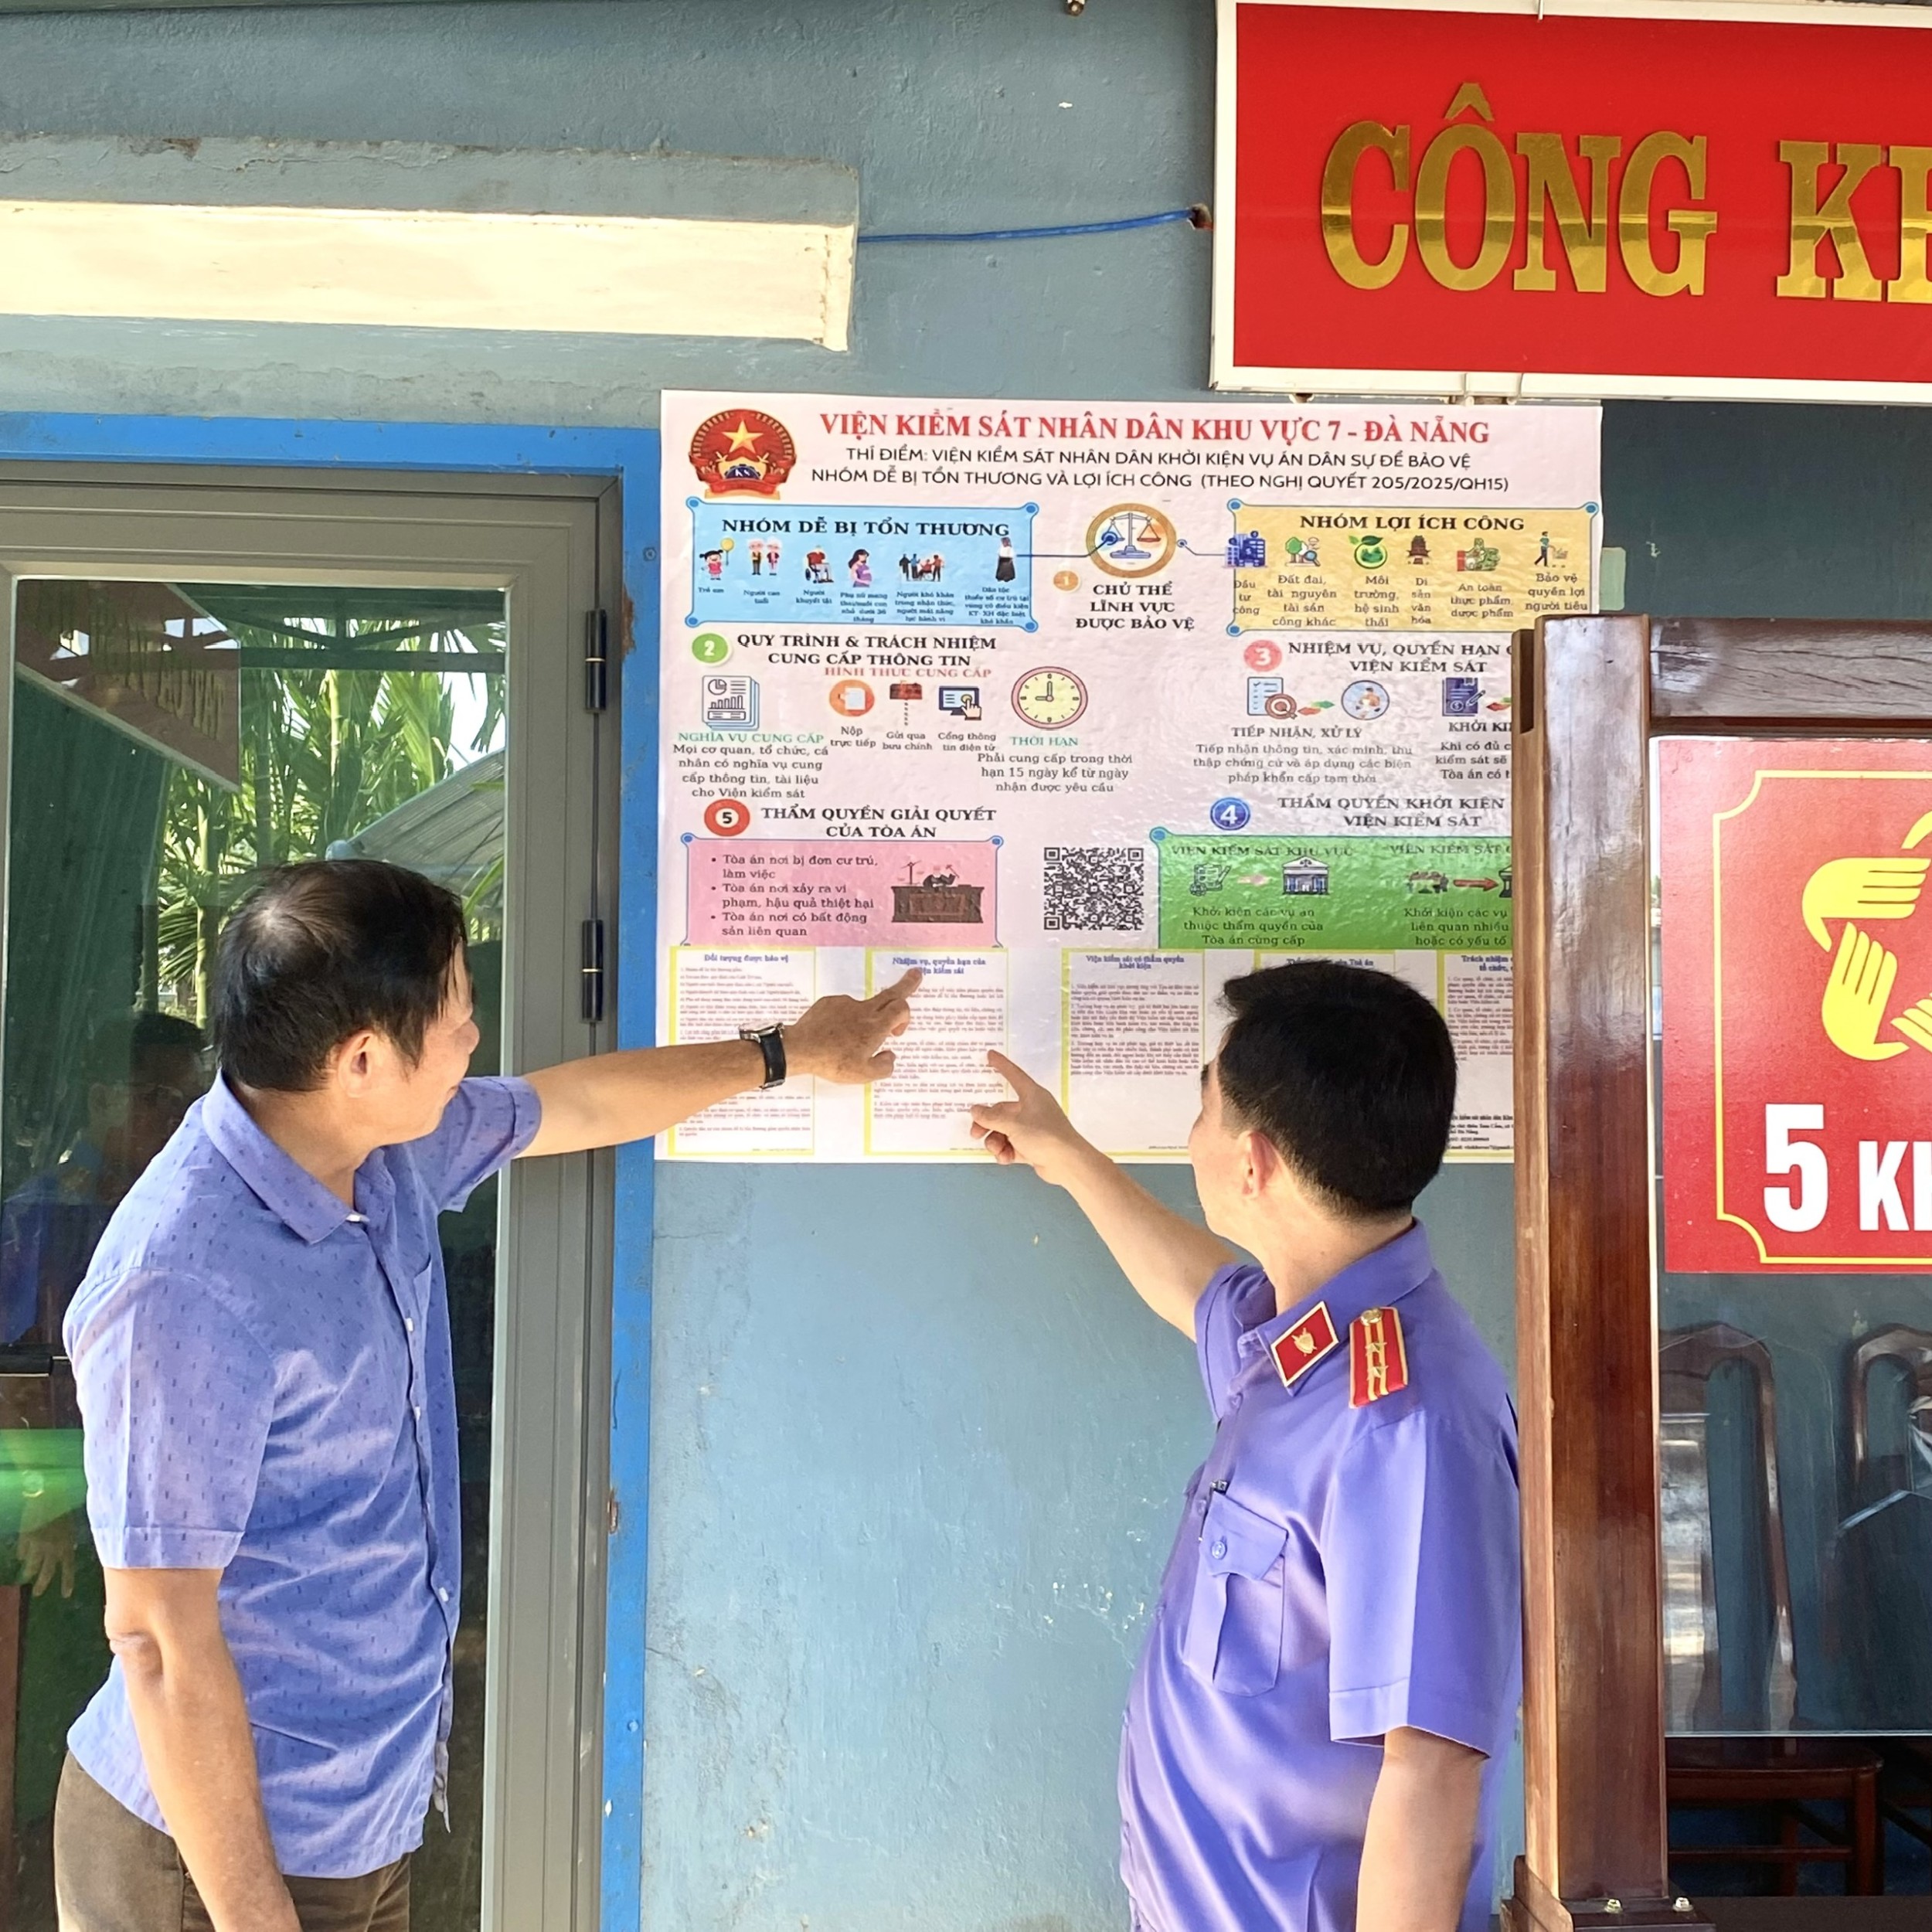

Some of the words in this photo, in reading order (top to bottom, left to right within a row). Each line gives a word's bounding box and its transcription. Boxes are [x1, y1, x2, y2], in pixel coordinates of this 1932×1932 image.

[1321, 82, 1718, 297] CÔNG
[820, 410, 887, 440] VIỆN
[896, 409, 970, 437] KIỂM
[978, 410, 1031, 437] SÁT
[1039, 411, 1117, 439] NHÂN
[1126, 411, 1183, 440] DÂN
[1192, 419, 1252, 440] KHU
[1260, 417, 1320, 445] VỰC
[1328, 420, 1341, 441] 7
[1365, 414, 1402, 442] ĐÀ
[1410, 415, 1488, 443] NẴNG
[846, 445, 874, 461] THÍ
[879, 444, 927, 461] ĐIỂM:
[932, 447, 971, 464] VIỆN
[978, 445, 1018, 463] KIỂM
[1023, 447, 1054, 463] SÁT
[1060, 448, 1109, 464] NHÂN
[1116, 449, 1152, 464] DÂN
[1158, 449, 1200, 465] KHỞI
[1206, 450, 1243, 468] KIỆN
[1249, 453, 1274, 468] VỤ
[1278, 451, 1302, 466] ÁN
[1308, 451, 1345, 467] DÂN
[1351, 454, 1376, 469] SỰ
[1380, 450, 1403, 467] ĐỂ
[1409, 452, 1444, 468] BẢO
[1449, 452, 1470, 470] VỆ
[812, 467, 868, 482] NHÓM
[873, 465, 896, 483] DỄ
[903, 471, 917, 485] BỊ
[922, 465, 958, 484] TỔN
[964, 471, 1042, 485] THƯƠNG
[1046, 470, 1069, 485] VÀ
[1074, 473, 1100, 488] LỢI
[1107, 471, 1134, 486] ÍCH
[1140, 471, 1192, 487] CÔNG
[1202, 474, 1254, 489] (THEO
[1260, 474, 1302, 491] NGHỊ
[1308, 471, 1366, 488] QUYẾT
[1372, 477, 1509, 492] 205/2025/QH15)
[723, 517, 791, 532] NHÓM
[799, 517, 827, 533] DỄ
[835, 521, 856, 536] BỊ
[864, 518, 909, 535] TỔN
[916, 522, 1009, 536] THƯƠNG
[1301, 513, 1368, 529] NHÓM
[1376, 517, 1410, 532] LỢI
[1419, 514, 1456, 530] ÍCH
[1464, 515, 1524, 530] CÔNG
[1278, 574, 1300, 583] Đất
[1366, 576, 1389, 584] Môi
[1094, 582, 1131, 595] CHỦ
[1137, 581, 1172, 595] THỂ
[1267, 588, 1283, 597] tài
[1291, 589, 1336, 600] nguyên
[1090, 600, 1133, 612] LĨNH
[1140, 602, 1175, 616] VỰC
[1077, 618, 1124, 631] ĐƯỢC
[1131, 615, 1166, 628] BẢO
[1172, 617, 1194, 631] VỆ
[1273, 617, 1301, 628] công
[704, 641, 715, 656] 2
[737, 634, 774, 648] QUY
[781, 633, 839, 648] TRÌNH
[845, 636, 859, 648] &
[866, 634, 927, 649] TRÁCH
[934, 635, 995, 651] NHIỆM
[1289, 640, 1351, 656] NHIỆM
[1461, 645, 1500, 658] HẠN
[768, 653, 820, 664] CUNG
[826, 651, 862, 665] CẤP
[867, 652, 933, 666] THÔNG
[939, 655, 970, 666] TIN
[1253, 648, 1272, 665] 3
[1350, 659, 1393, 674] VIỆN
[1400, 658, 1447, 672] KIỂM
[1454, 661, 1487, 672] SÁT
[673, 744, 696, 755] Mọi
[815, 745, 828, 755] cá
[679, 758, 709, 767] nhân
[714, 758, 729, 768] có
[733, 758, 768, 770] nghĩa
[772, 761, 787, 770] vụ
[792, 761, 822, 771] cung
[978, 752, 1005, 763] Phải
[1009, 756, 1039, 765] cung
[1044, 753, 1066, 765] cấp
[1070, 754, 1104, 765] trong
[1108, 753, 1132, 764] thời
[682, 773, 705, 785] cấp
[709, 773, 745, 785] thông
[775, 774, 791, 784] tài
[796, 774, 818, 785] liệu
[981, 767, 1004, 779] hạn
[1010, 767, 1023, 777] 15
[1029, 767, 1058, 780] ngày
[1082, 767, 1095, 778] từ
[1099, 767, 1128, 781] ngày
[1440, 769, 1463, 779] Tòa
[1468, 769, 1483, 779] án
[1487, 769, 1501, 779] có
[692, 787, 715, 798] cho
[719, 787, 747, 798] Viện
[787, 788, 805, 798] sát
[996, 782, 1026, 793] nhận
[1031, 782, 1060, 793] được
[1066, 782, 1087, 794] yêu
[1277, 795, 1331, 808] THẨM
[722, 811, 733, 825] 5
[761, 804, 815, 819] THẨM
[822, 804, 884, 821] QUYỀN
[891, 805, 929, 821] GIẢI
[936, 805, 996, 822] QUYẾT
[1219, 804, 1239, 825] 4
[1343, 814, 1386, 828] VIỆN
[1393, 812, 1441, 827] KIỂM
[826, 825, 863, 837] CỦA
[869, 825, 905, 837] TÒA
[911, 825, 936, 837] ÁN
[723, 855, 745, 865] Tòa
[750, 855, 764, 865] án
[770, 855, 788, 865] nơi
[793, 855, 804, 867] bị
[809, 855, 832, 866] đơn
[836, 857, 852, 866] cư
[723, 869, 746, 879] làm
[750, 869, 775, 880] việc
[1202, 934, 1225, 944] Tòa
[1229, 934, 1243, 945] án
[1247, 935, 1278, 947] cùng
[1283, 934, 1305, 947] cấp
[1415, 935, 1445, 946] hoặc
[1448, 935, 1464, 945] có
[1764, 1103, 1828, 1233] 5
